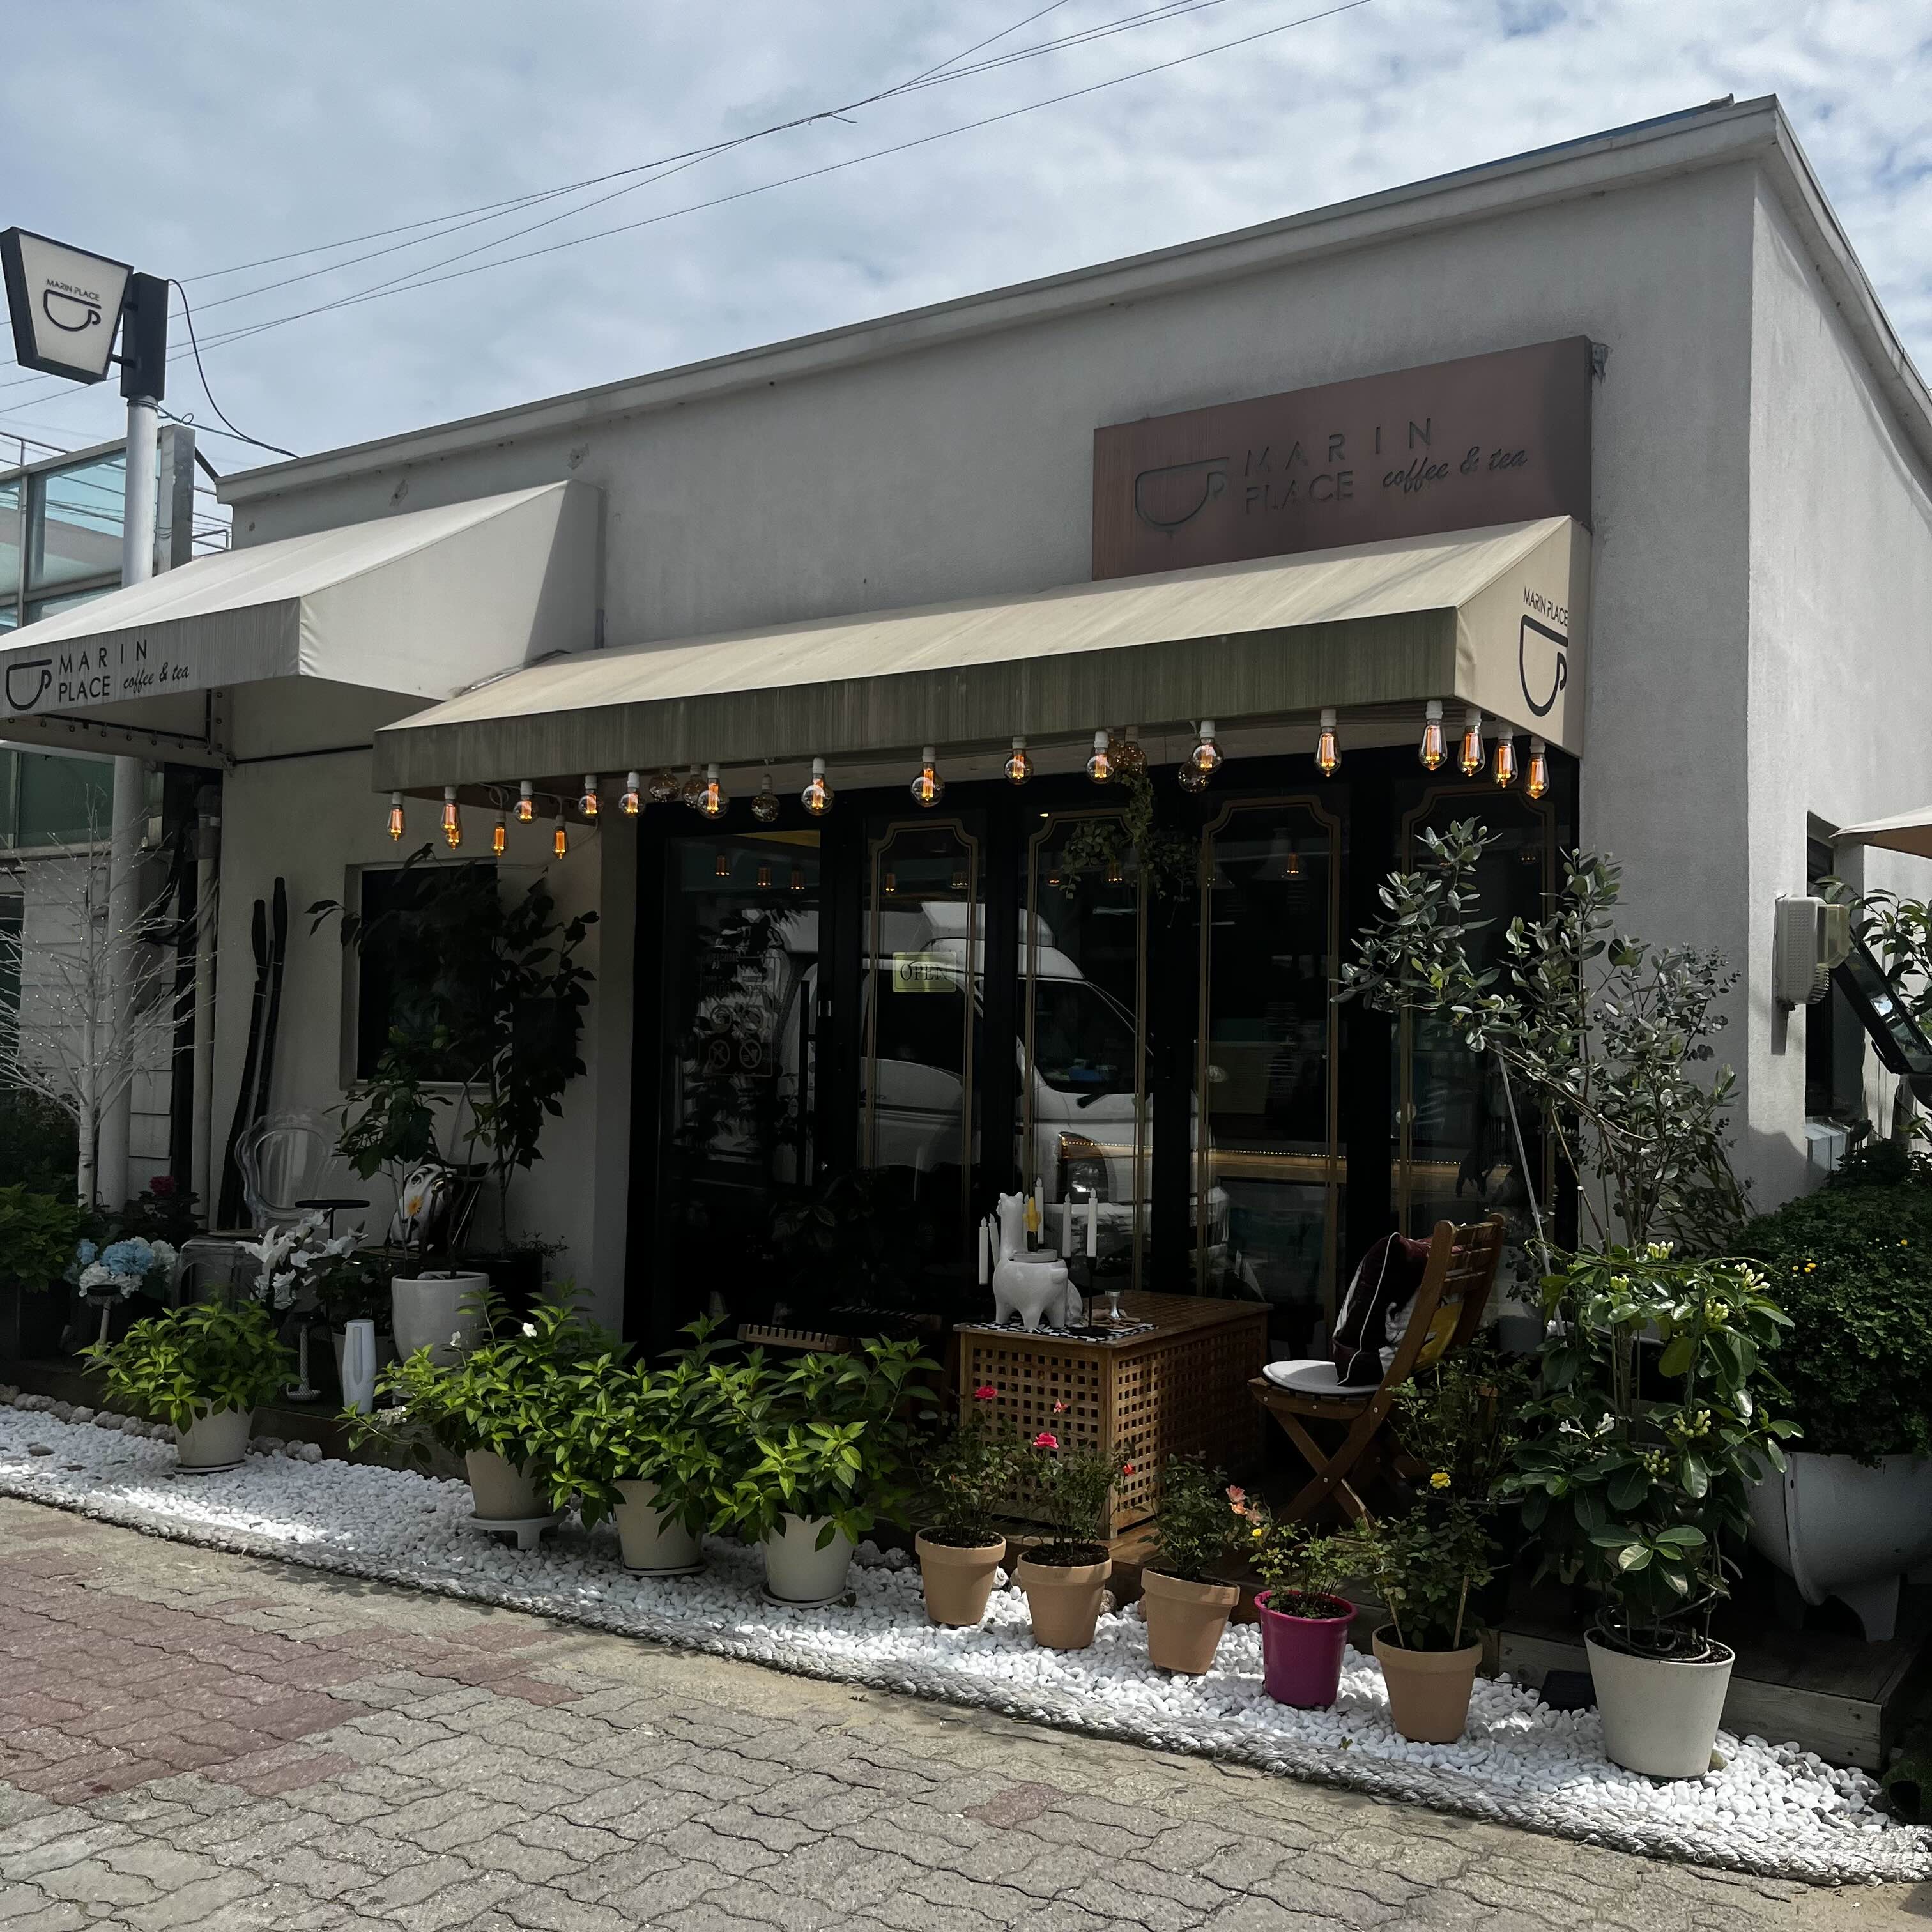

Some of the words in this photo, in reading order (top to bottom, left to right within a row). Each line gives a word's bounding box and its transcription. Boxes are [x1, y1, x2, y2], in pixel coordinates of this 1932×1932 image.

[47, 278, 72, 292] MARIN
[75, 286, 100, 301] PLACE
[1245, 418, 1432, 476] MARIN
[1246, 470, 1354, 513] PLACE
[1382, 456, 1449, 494] coffee
[1460, 446, 1480, 474] &
[1489, 448, 1528, 471] tea
[1523, 586, 1546, 615] MARIN
[1547, 600, 1568, 627] PLACE
[59, 639, 147, 675] MARIN
[59, 675, 111, 702] PLACE
[123, 668, 154, 694] coffee
[159, 661, 169, 682] &
[172, 664, 189, 681] tea
